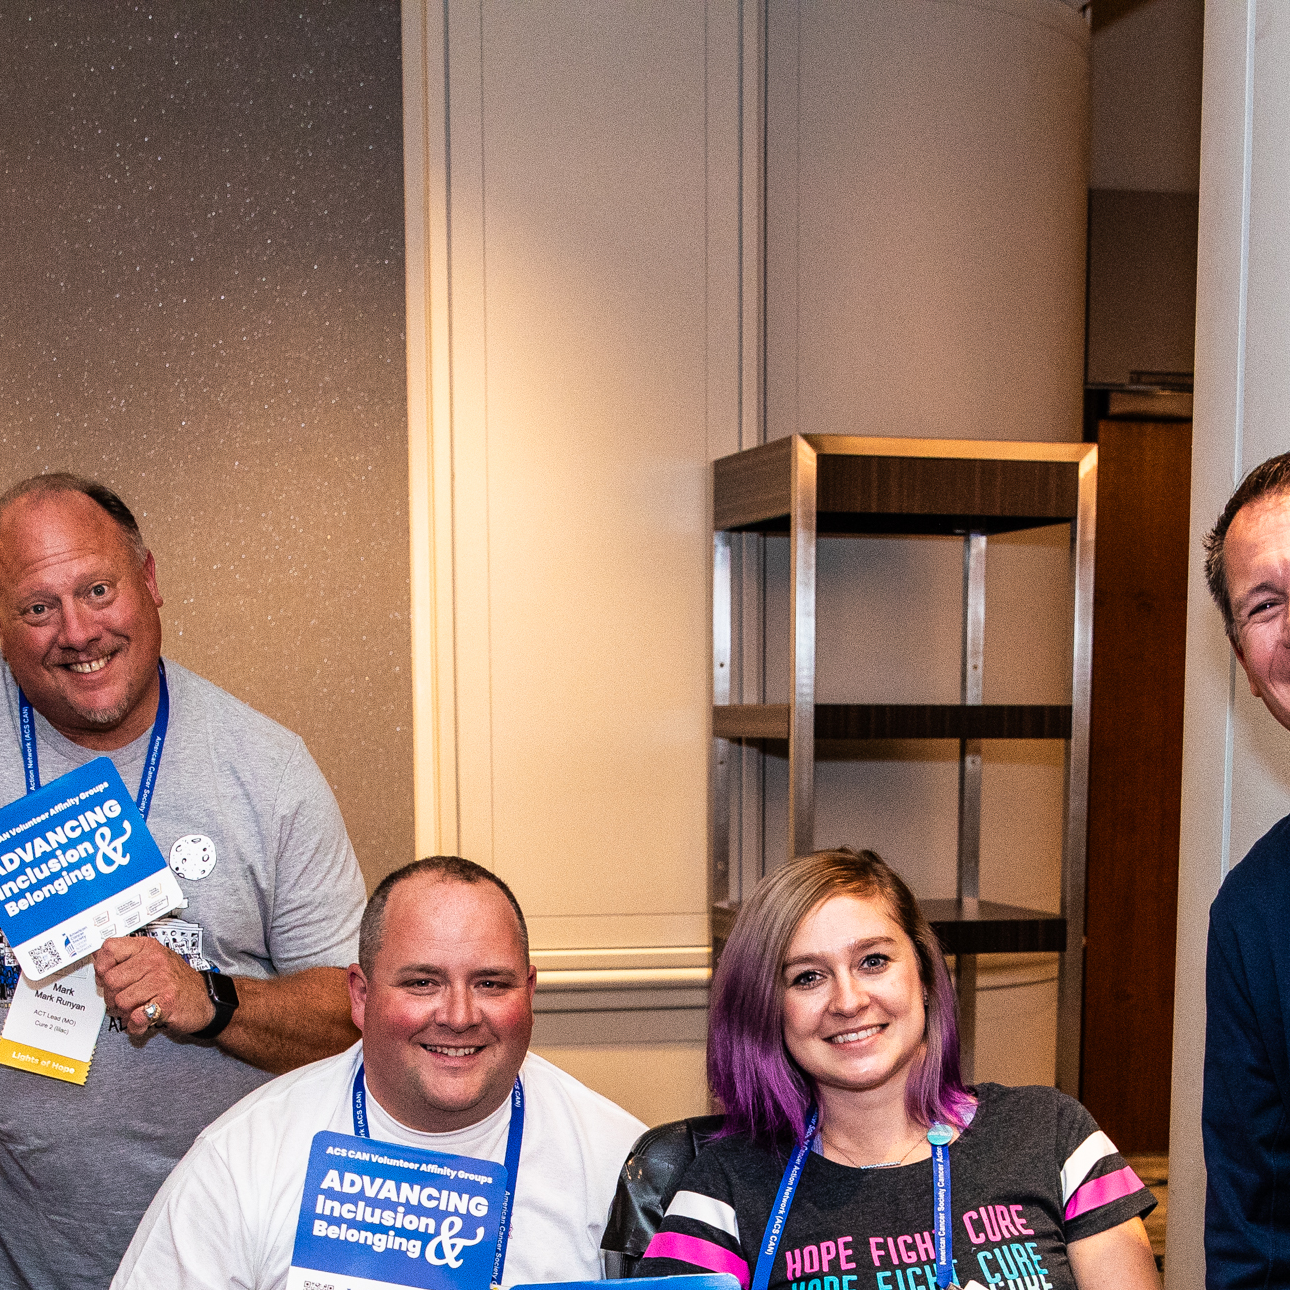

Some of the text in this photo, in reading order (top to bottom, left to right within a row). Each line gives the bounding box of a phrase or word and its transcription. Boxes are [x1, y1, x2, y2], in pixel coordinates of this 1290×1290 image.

[26, 743, 34, 771] Network
[150, 736, 162, 765] American
[146, 766, 156, 788] Cancer
[9, 812, 49, 837] Volunteer
[49, 797, 80, 821] Affinity
[79, 781, 109, 801] Groups
[139, 788, 149, 813] Society
[93, 819, 132, 874] &
[4, 865, 94, 918] Belonging
[35, 990, 85, 1011] Mark Runyan
[53, 983, 75, 996] Mark
[35, 1020, 48, 1028] Cure
[47, 1013, 61, 1021] Lead
[62, 1017, 76, 1027] (MO)
[12, 1051, 39, 1064] Lights
[52, 1062, 75, 1074] Hope
[357, 1111, 365, 1128] (ACS
[326, 1146, 493, 1185] ACS CAN Volunteer Affinity Groups
[937, 1164, 945, 1188] Cancer
[320, 1169, 488, 1217] ADVANCING
[937, 1188, 946, 1211] Society
[500, 1191, 511, 1224] American
[765, 1165, 800, 1256] Action Network (ACS CAN)
[312, 1220, 422, 1258] Belonging
[315, 1195, 485, 1269] Inclusion &
[496, 1226, 506, 1251] Cancer
[785, 1204, 1035, 1281] HOPE FIGH CURE
[939, 1237, 947, 1266] American
[976, 1242, 1049, 1284] CURE
[492, 1253, 501, 1281] Society
